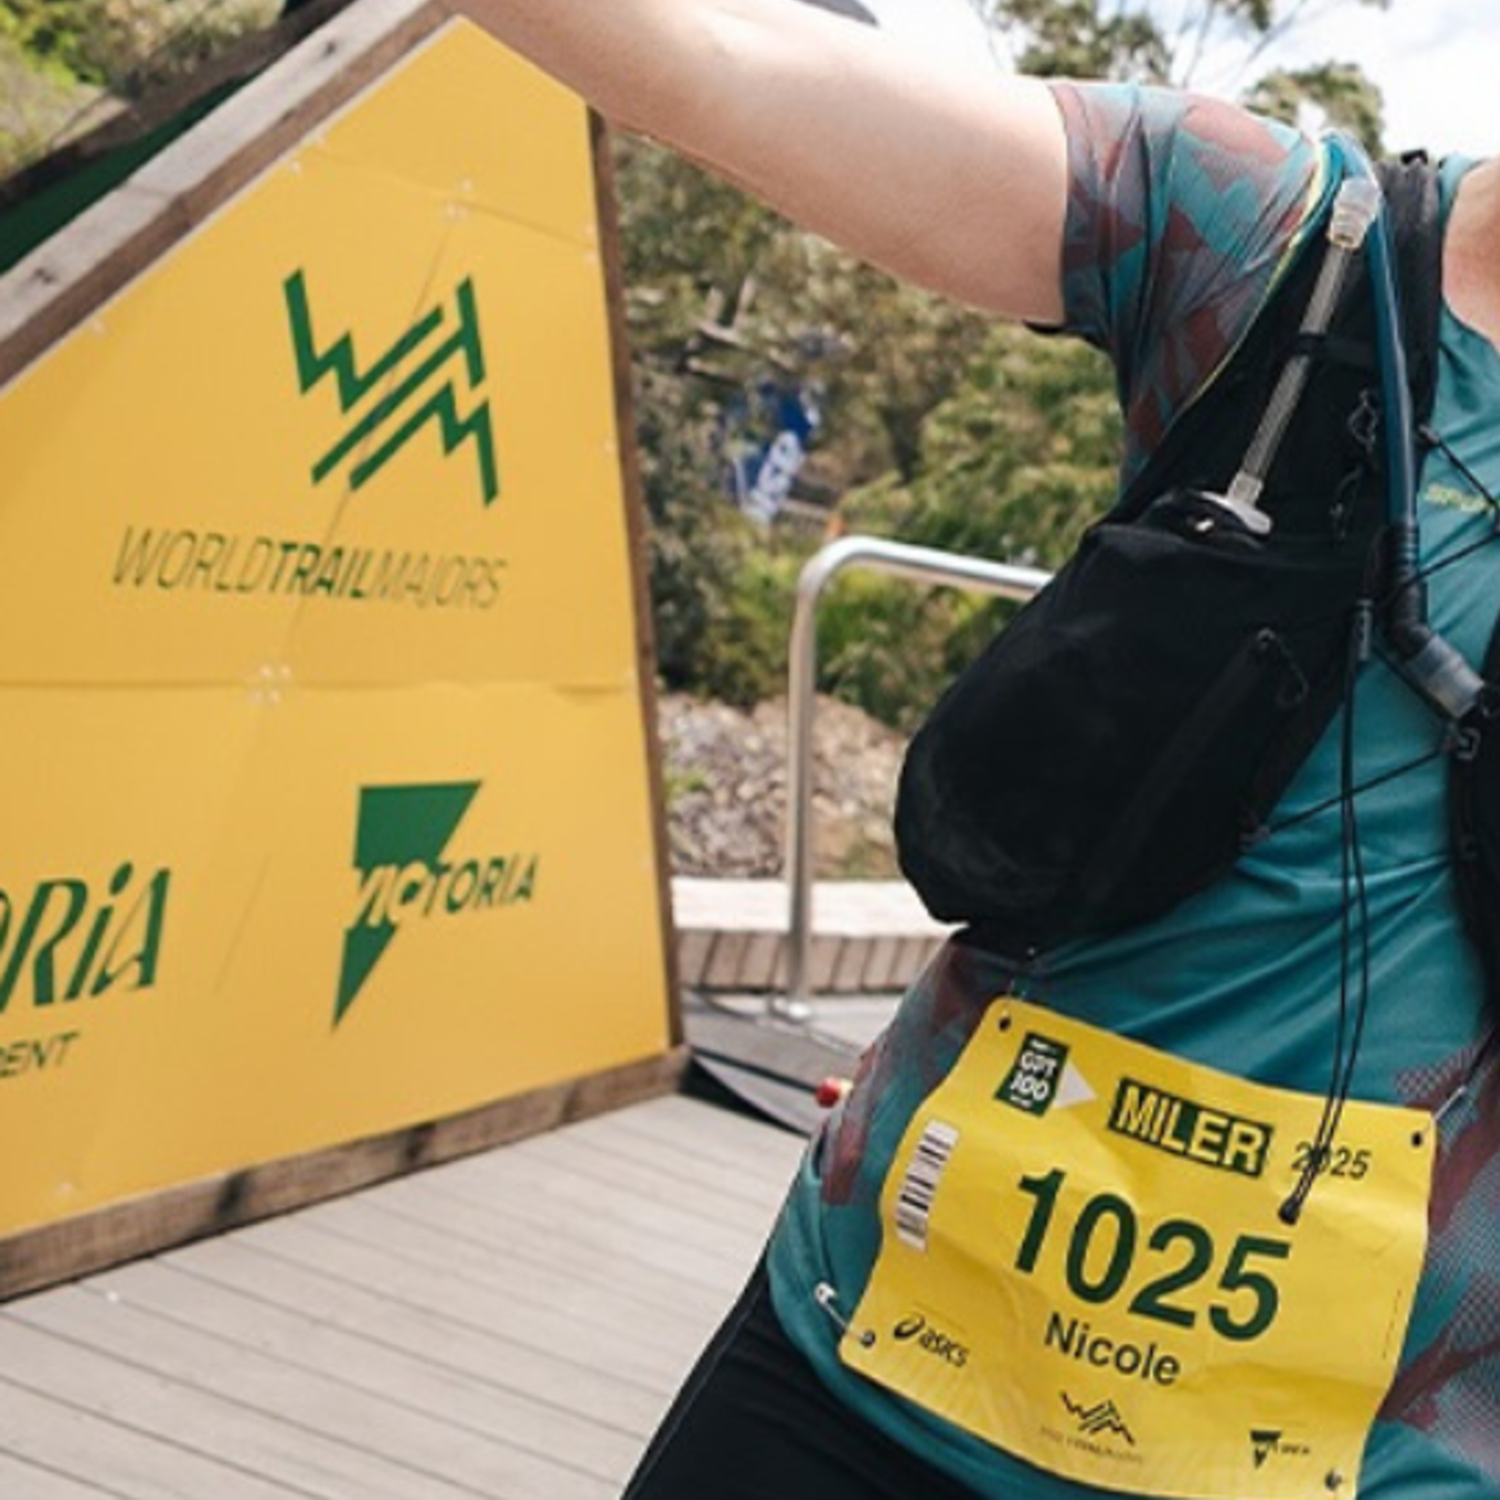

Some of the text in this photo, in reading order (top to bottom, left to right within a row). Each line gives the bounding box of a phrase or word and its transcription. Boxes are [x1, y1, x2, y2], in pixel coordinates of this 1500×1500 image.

[112, 524, 508, 610] WORLDTRAILMAJORS
[1010, 1071, 1049, 1101] 100
[1116, 1084, 1263, 1175] MILER
[1291, 1141, 1372, 1181] 225
[1013, 1168, 1292, 1341] 1025
[1044, 1312, 1182, 1386] Nicole
